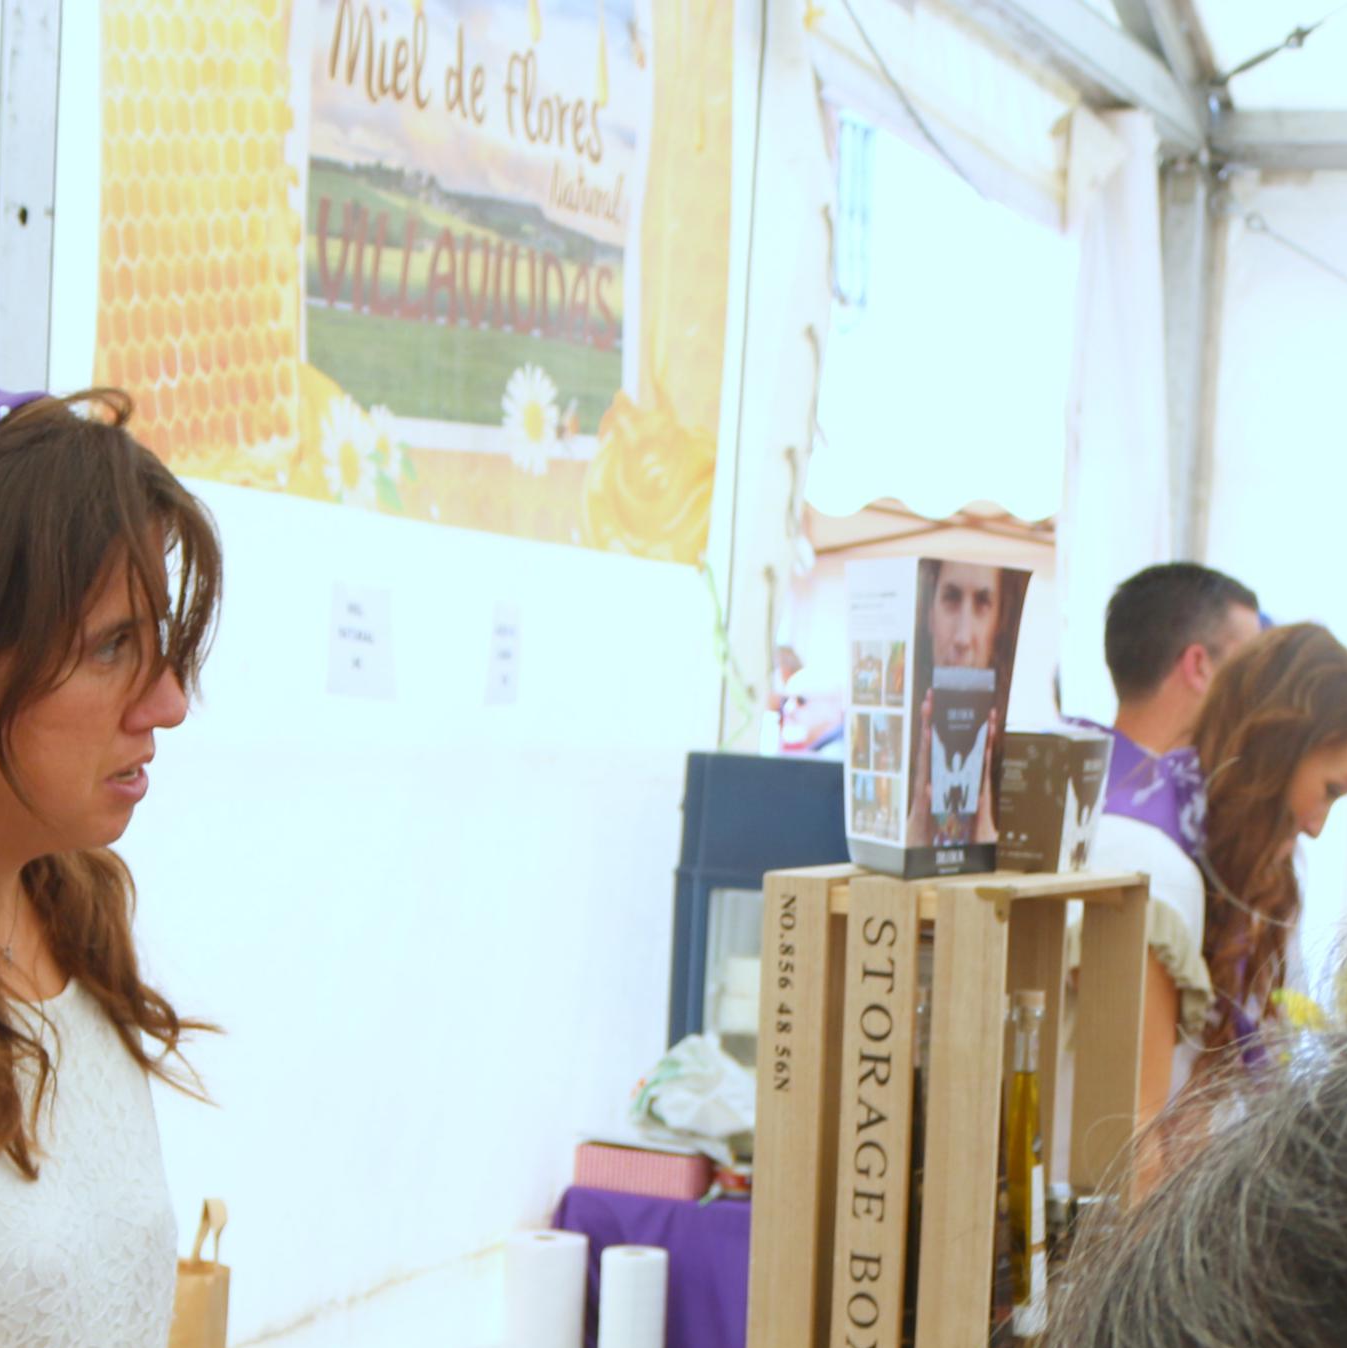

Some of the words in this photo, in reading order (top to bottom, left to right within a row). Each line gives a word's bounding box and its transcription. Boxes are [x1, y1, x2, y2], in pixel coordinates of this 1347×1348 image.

[329, 0, 431, 110] Miel
[445, 23, 486, 126] de
[505, 49, 603, 164] flores
[314, 193, 619, 351] VILLAVIUDAS
[772, 1044, 792, 1092] 56N
[776, 1000, 794, 1035] 48
[851, 916, 898, 1225] STORAGE
